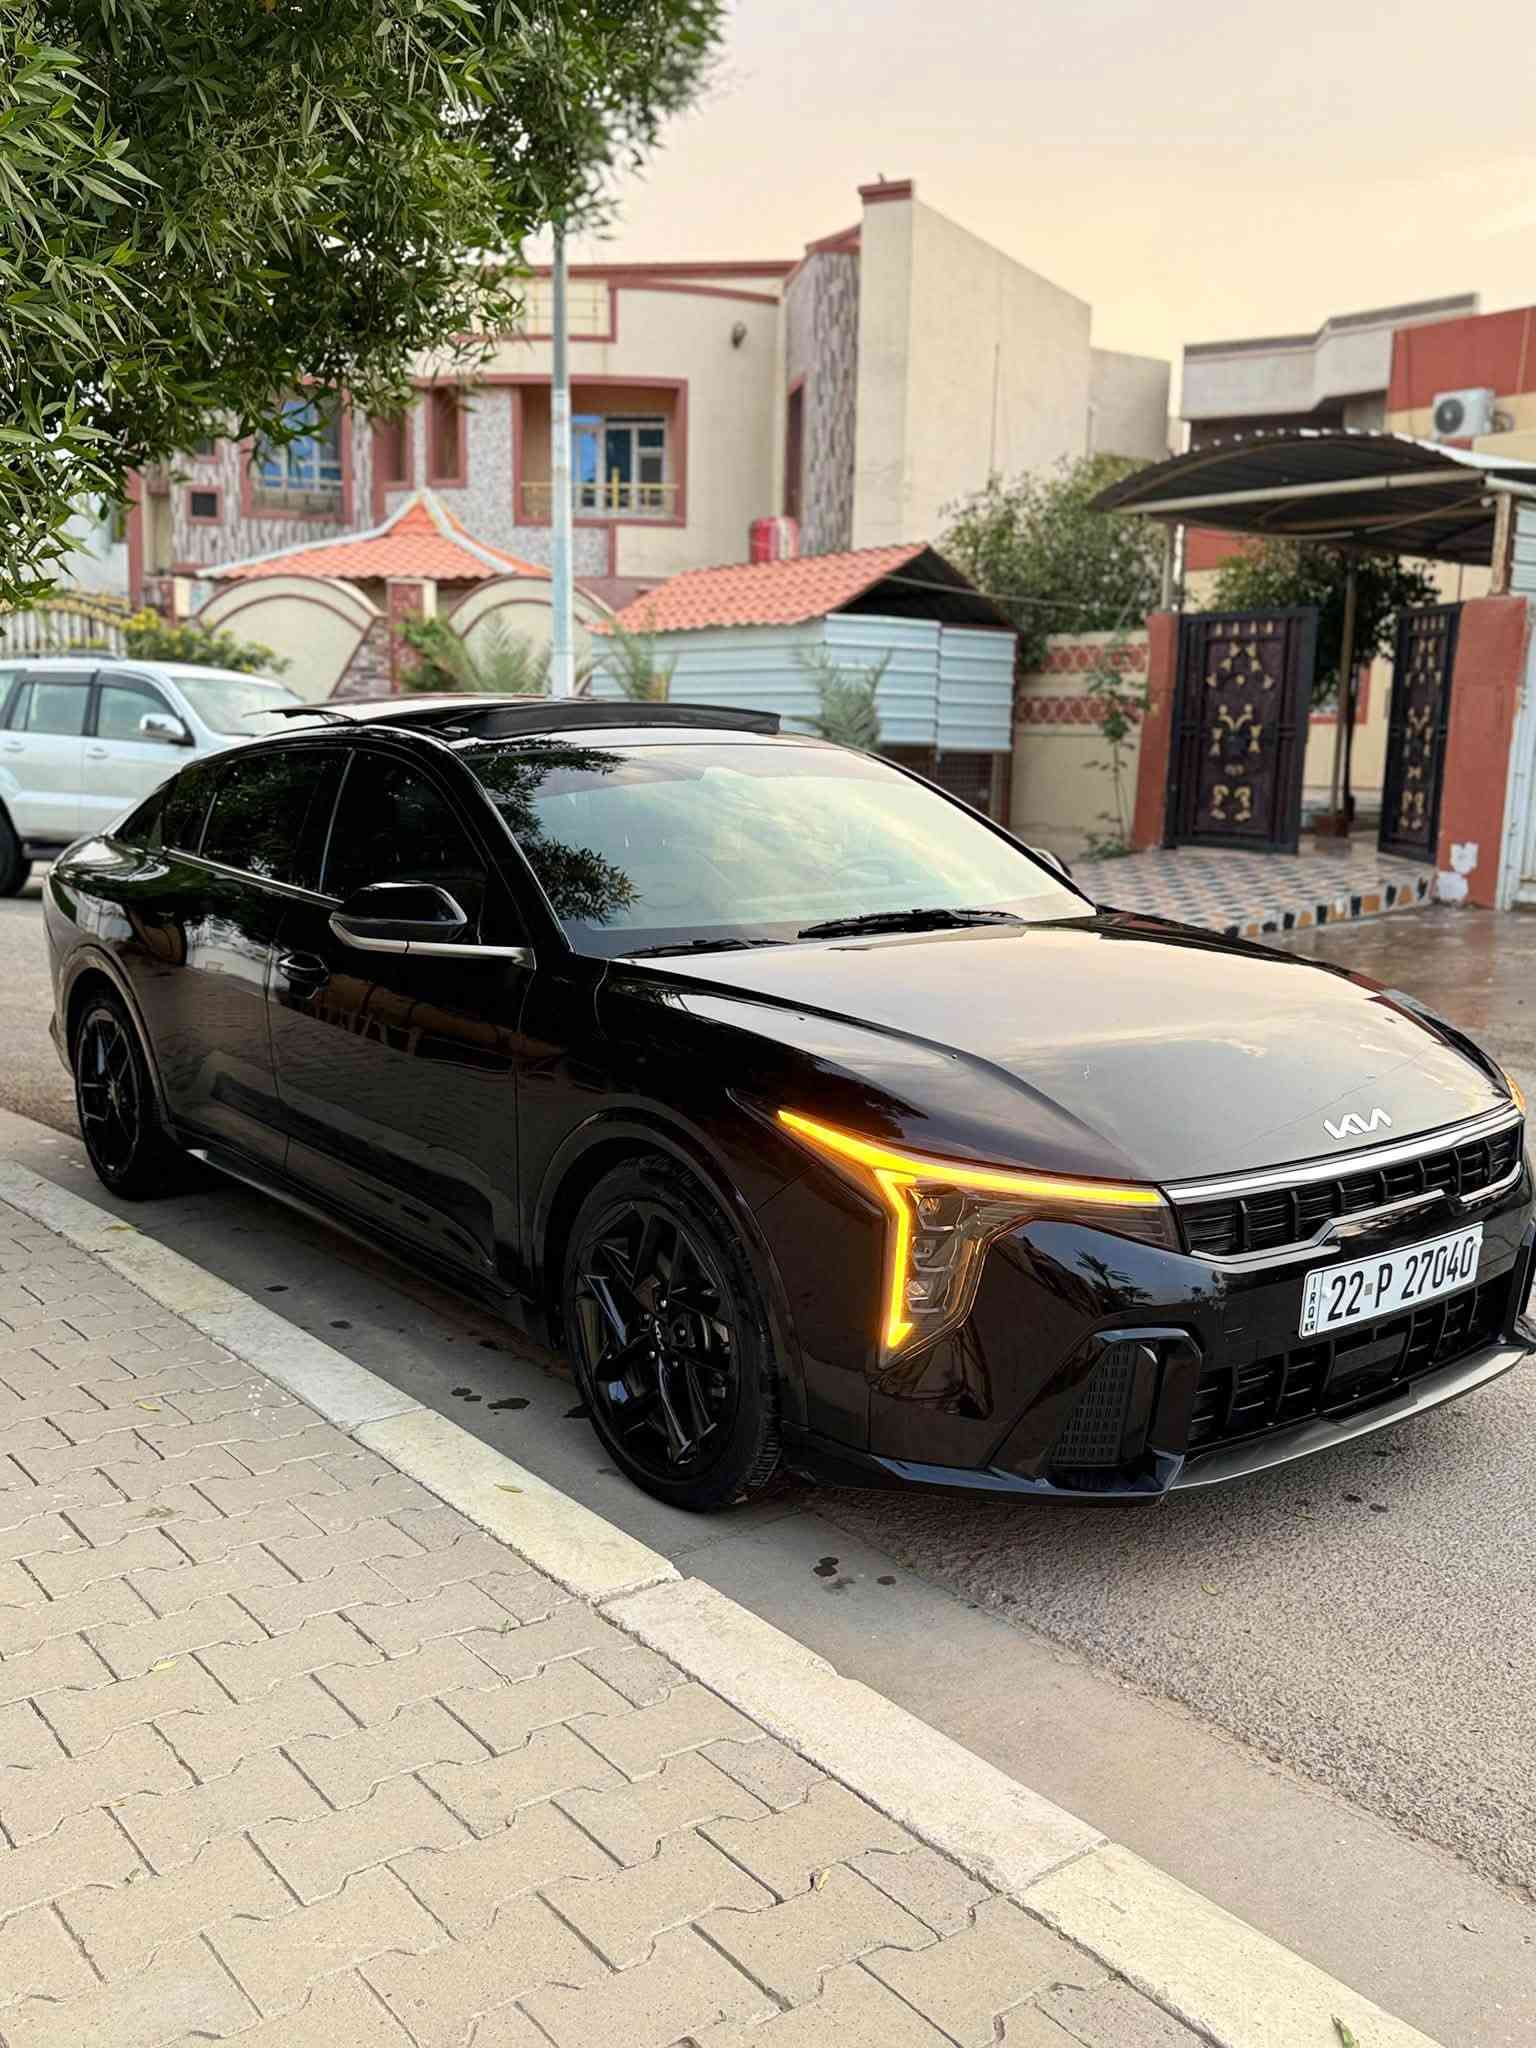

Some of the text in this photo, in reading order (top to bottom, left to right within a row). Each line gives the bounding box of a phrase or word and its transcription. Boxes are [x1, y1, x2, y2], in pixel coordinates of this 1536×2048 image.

[1327, 1235, 1474, 1322] 22 P 27040
